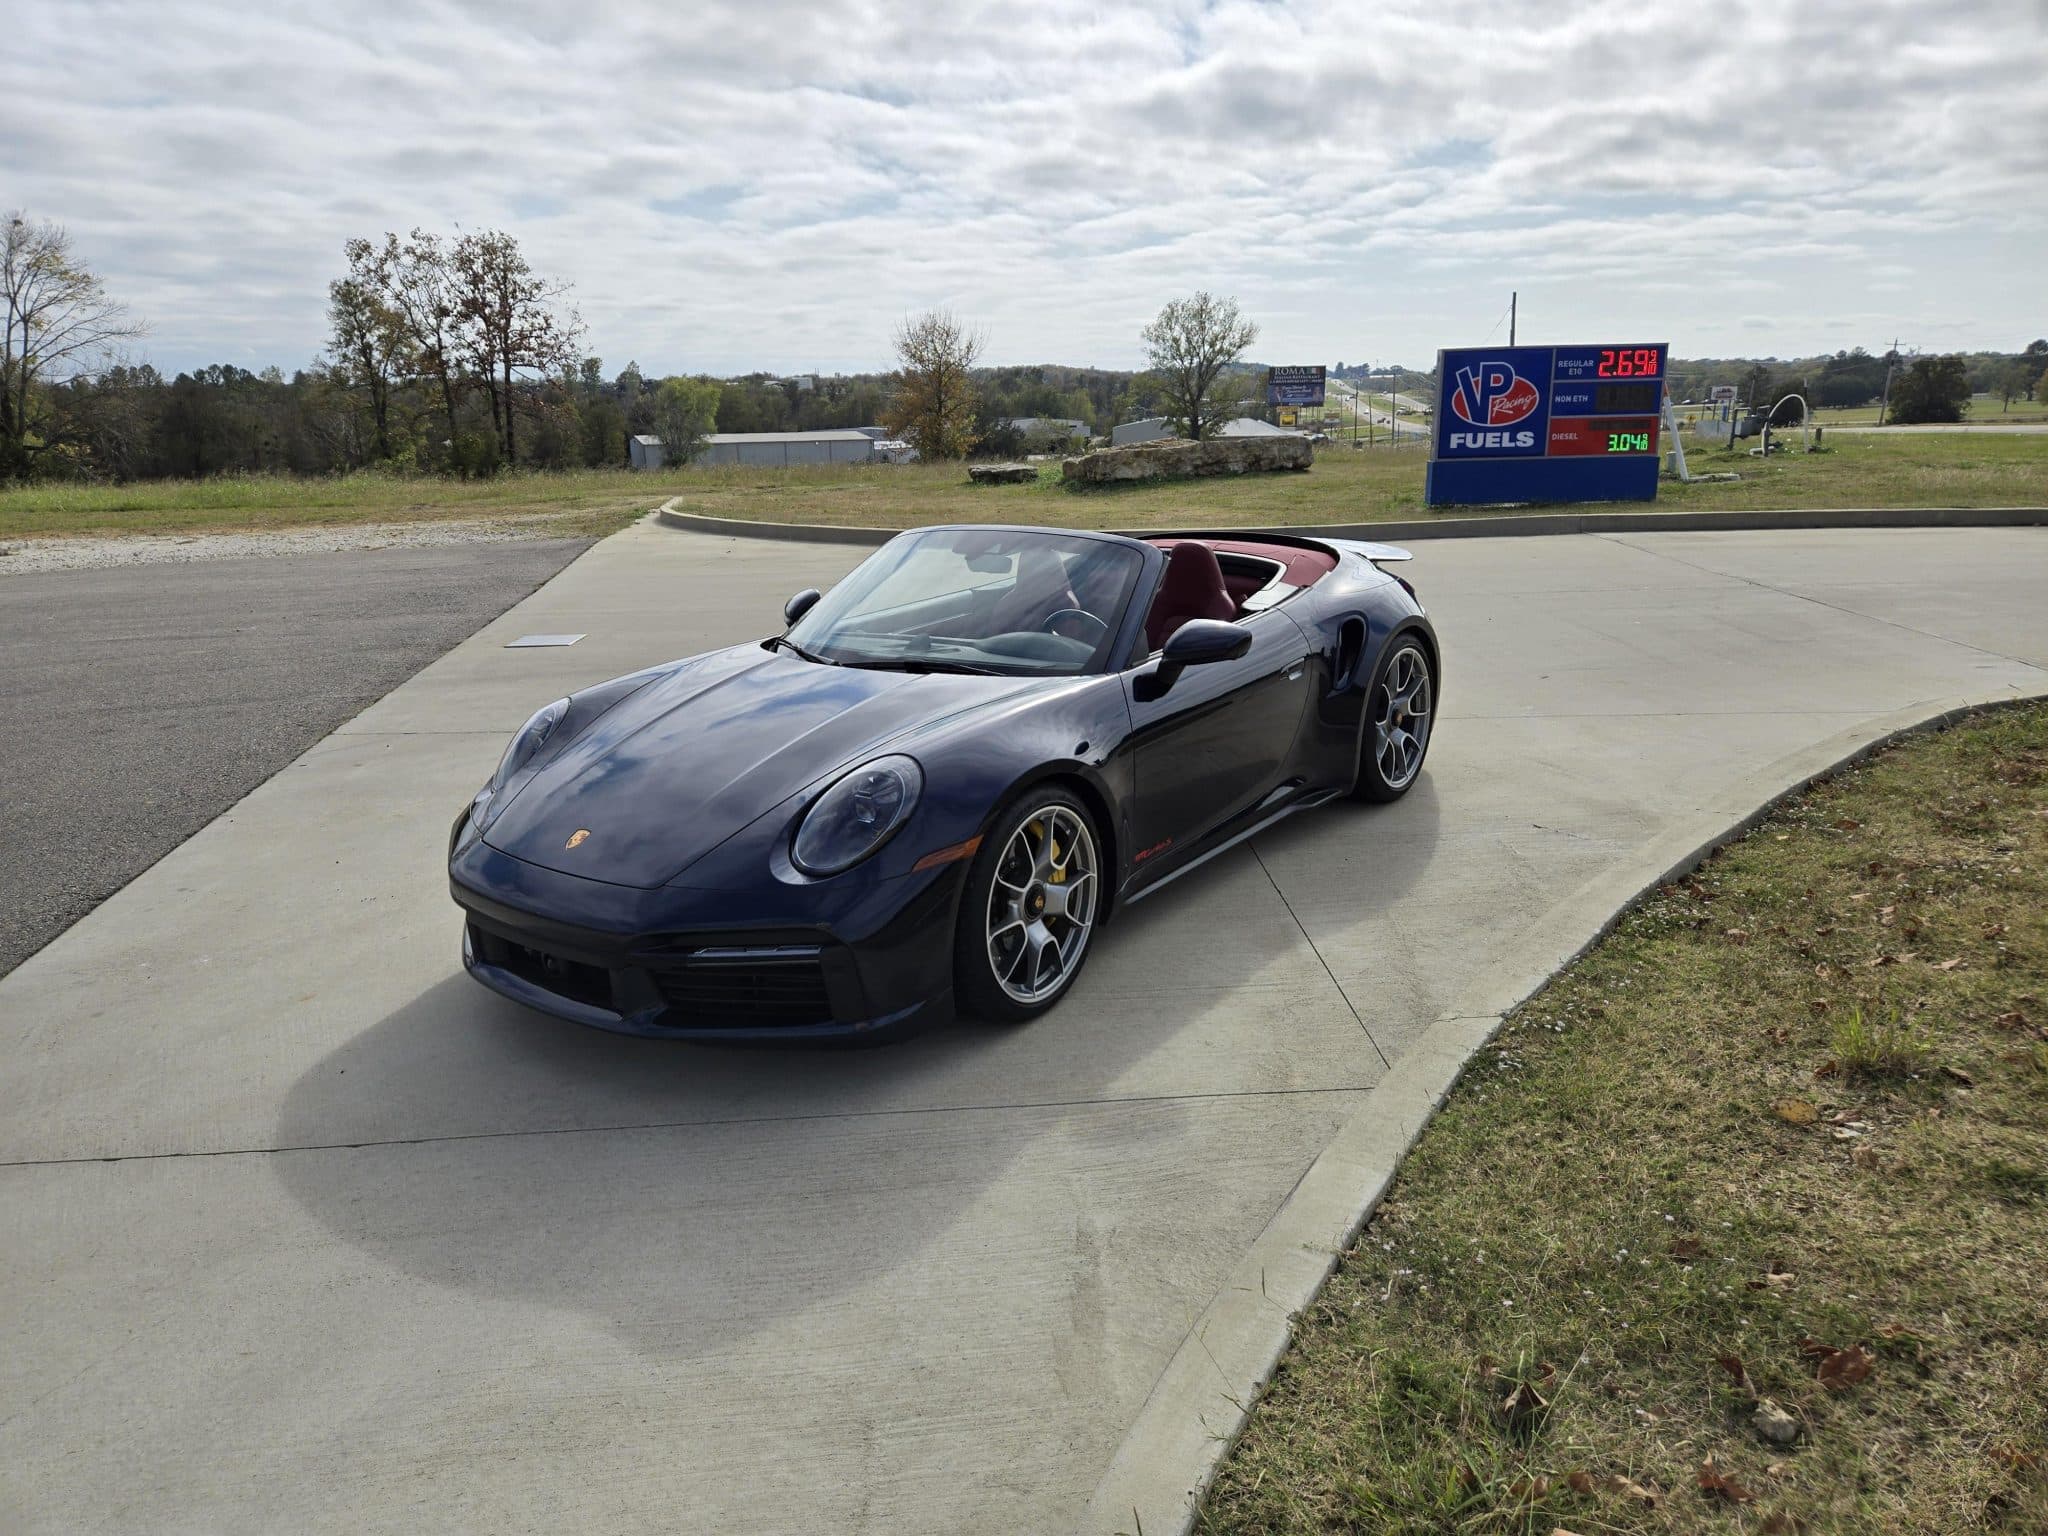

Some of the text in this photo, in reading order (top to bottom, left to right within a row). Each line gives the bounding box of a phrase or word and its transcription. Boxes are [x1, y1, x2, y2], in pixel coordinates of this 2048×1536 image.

[1558, 360, 1594, 368] REGULAR
[1598, 349, 1648, 376] 2.69
[1275, 367, 1305, 376] ROMA
[1568, 368, 1582, 376] E10
[1455, 361, 1516, 425] VP
[1555, 395, 1571, 403] NON
[1492, 393, 1537, 417] Racing
[1450, 431, 1535, 449] FUELS
[1552, 432, 1578, 440] DIESEL
